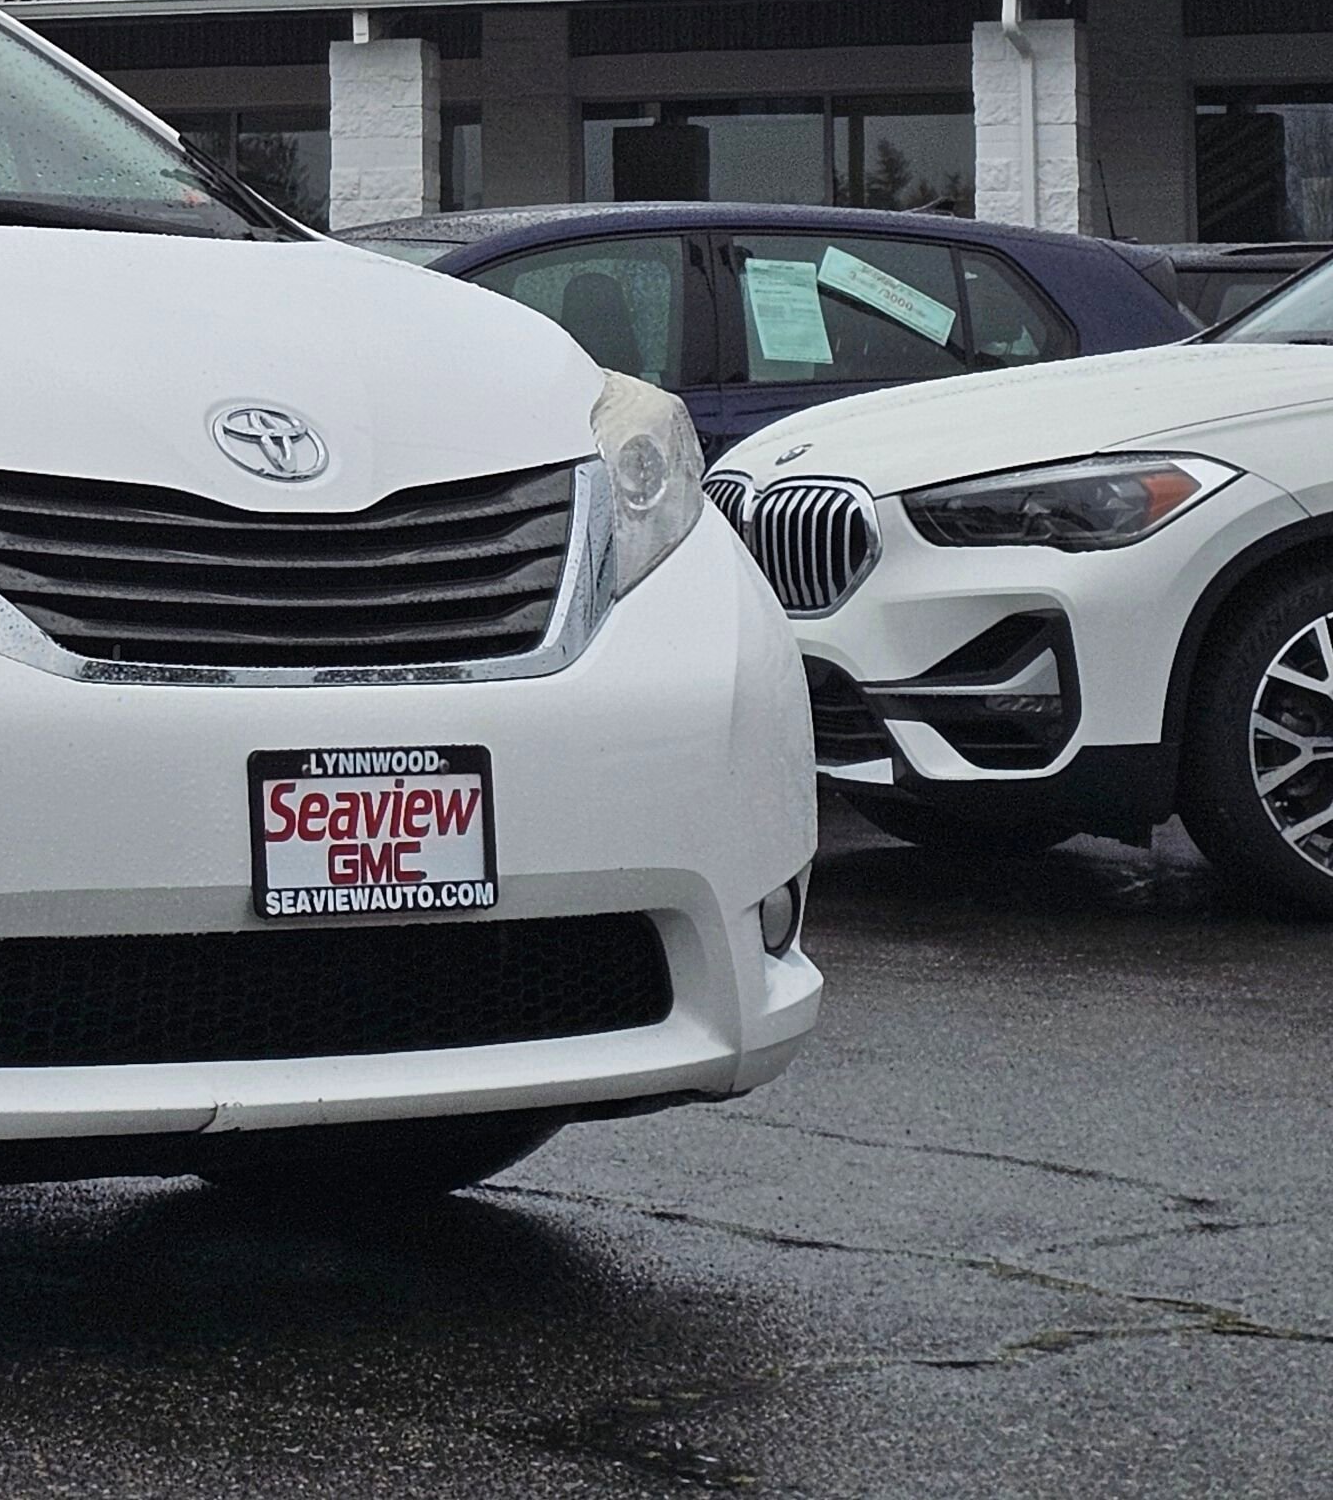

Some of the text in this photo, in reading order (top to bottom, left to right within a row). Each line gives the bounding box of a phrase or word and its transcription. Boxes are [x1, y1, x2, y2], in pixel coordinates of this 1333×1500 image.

[309, 750, 440, 776] LYNNWOOD
[265, 778, 481, 843] Seaview
[327, 840, 423, 886] GMC
[265, 882, 495, 917] SEAVIEWAUTO.COM
